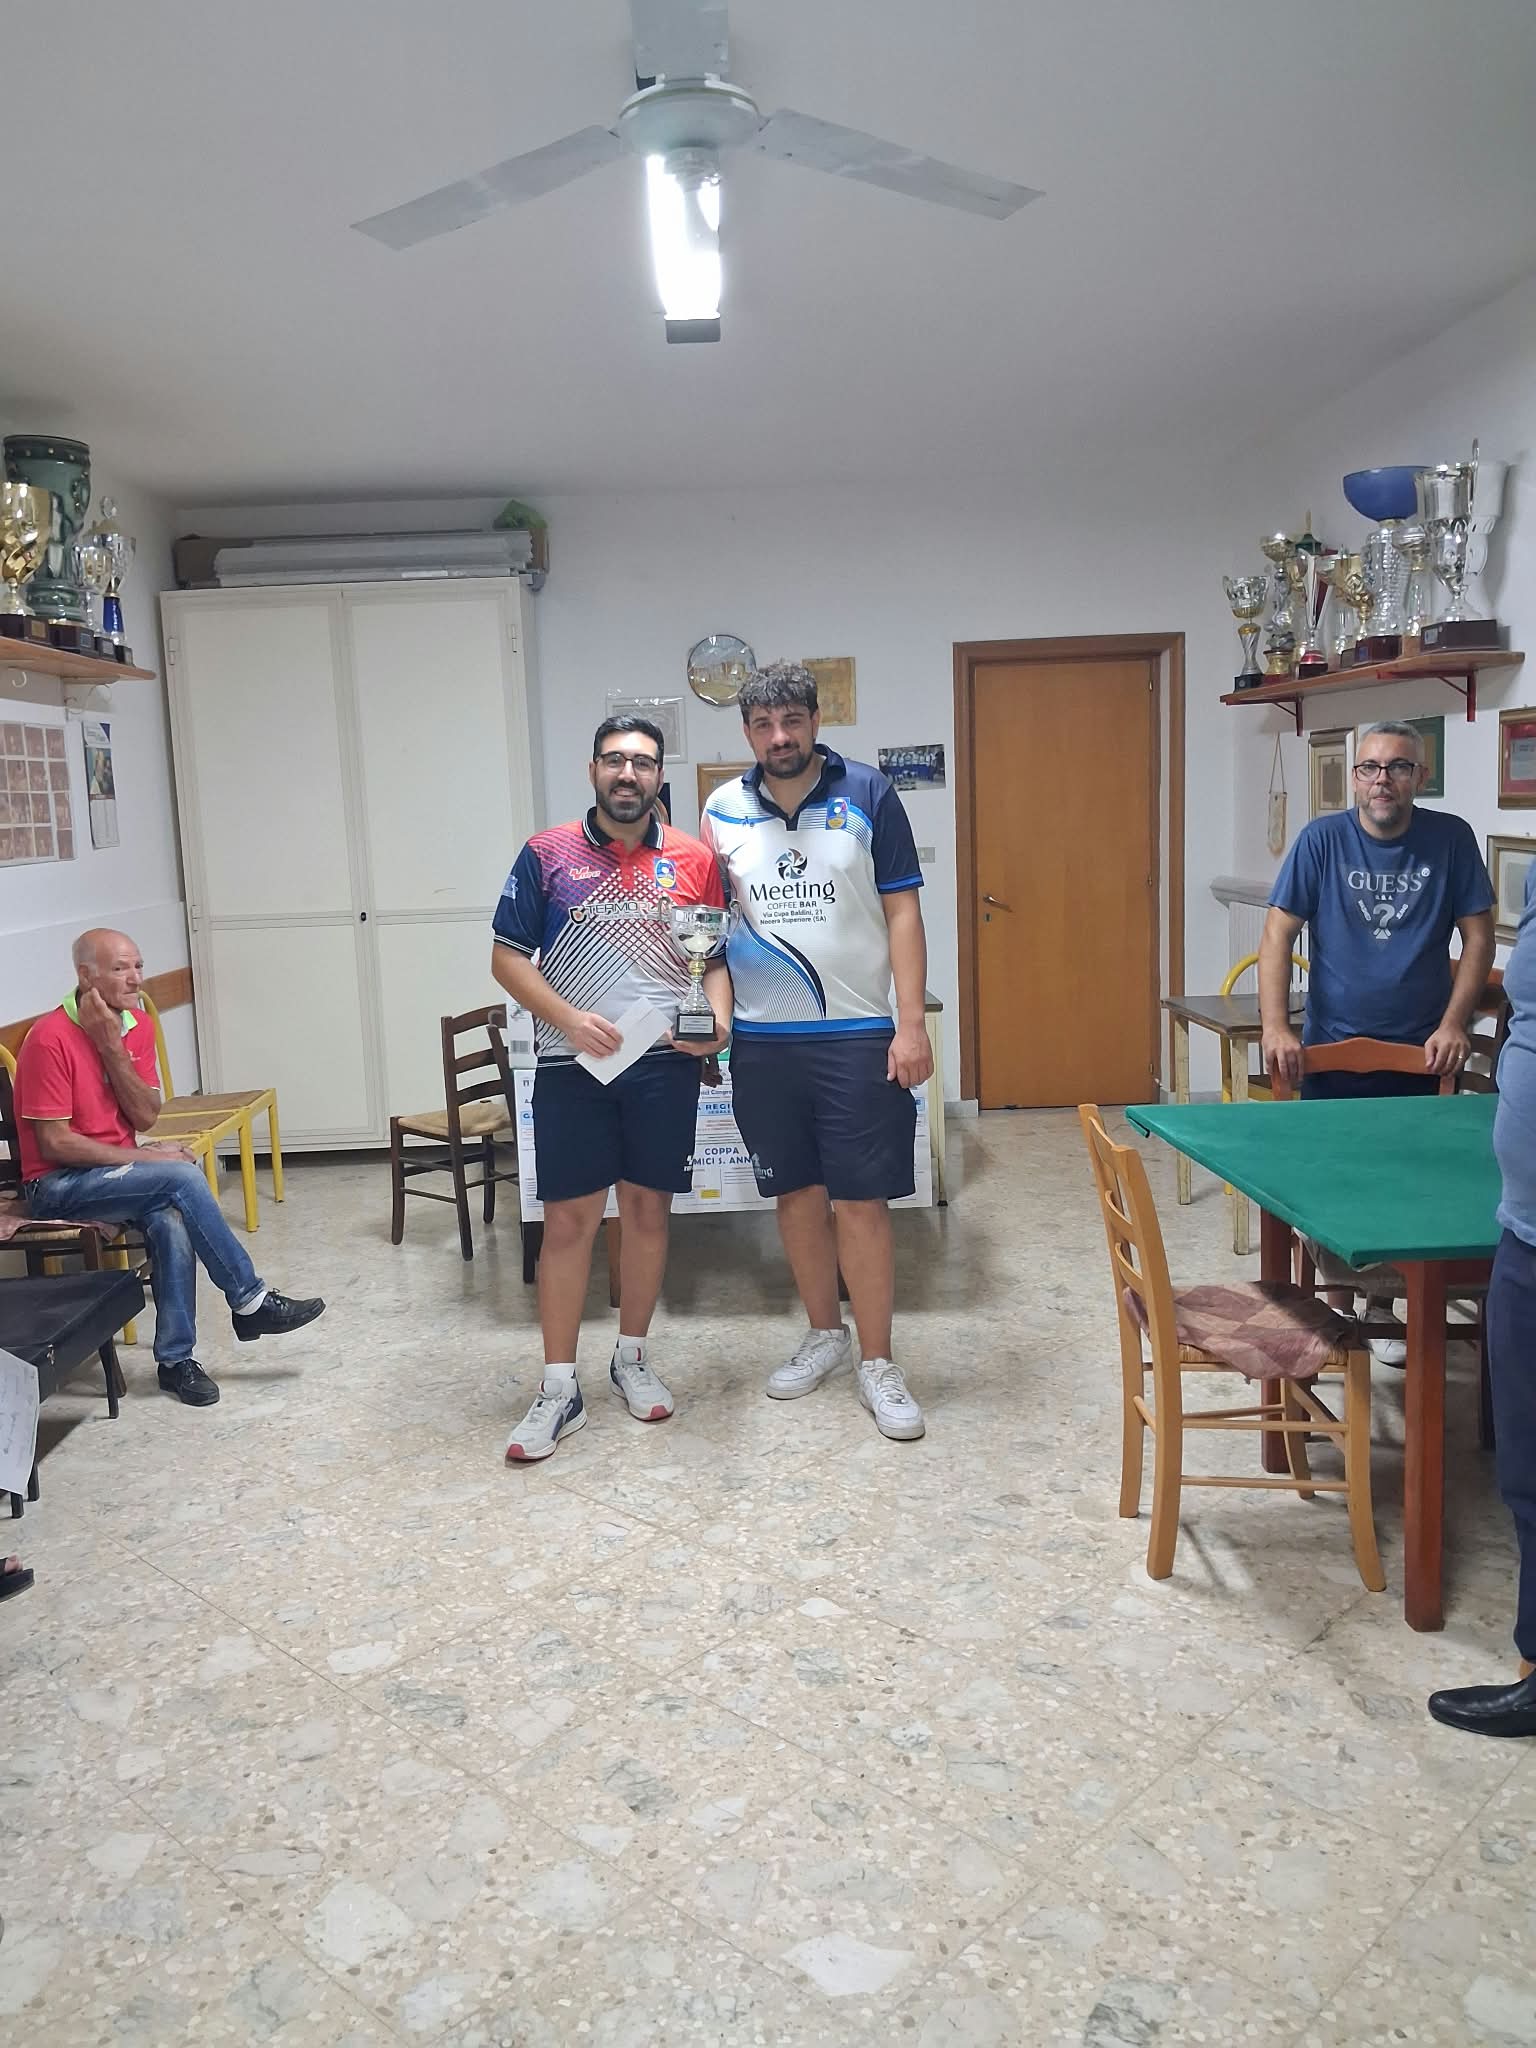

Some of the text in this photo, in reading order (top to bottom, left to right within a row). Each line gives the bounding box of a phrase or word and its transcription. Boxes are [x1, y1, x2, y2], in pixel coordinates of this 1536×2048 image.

[1347, 870, 1422, 893] GUESS
[750, 880, 835, 904] Meeting
[767, 900, 818, 910] COFFEE BAR
[760, 914, 827, 926] Nocera Superiore (SA)
[705, 1103, 731, 1111] REGI
[704, 1146, 740, 1156] COPPA
[693, 1156, 715, 1166] MICI
[729, 1156, 751, 1165] ANN
